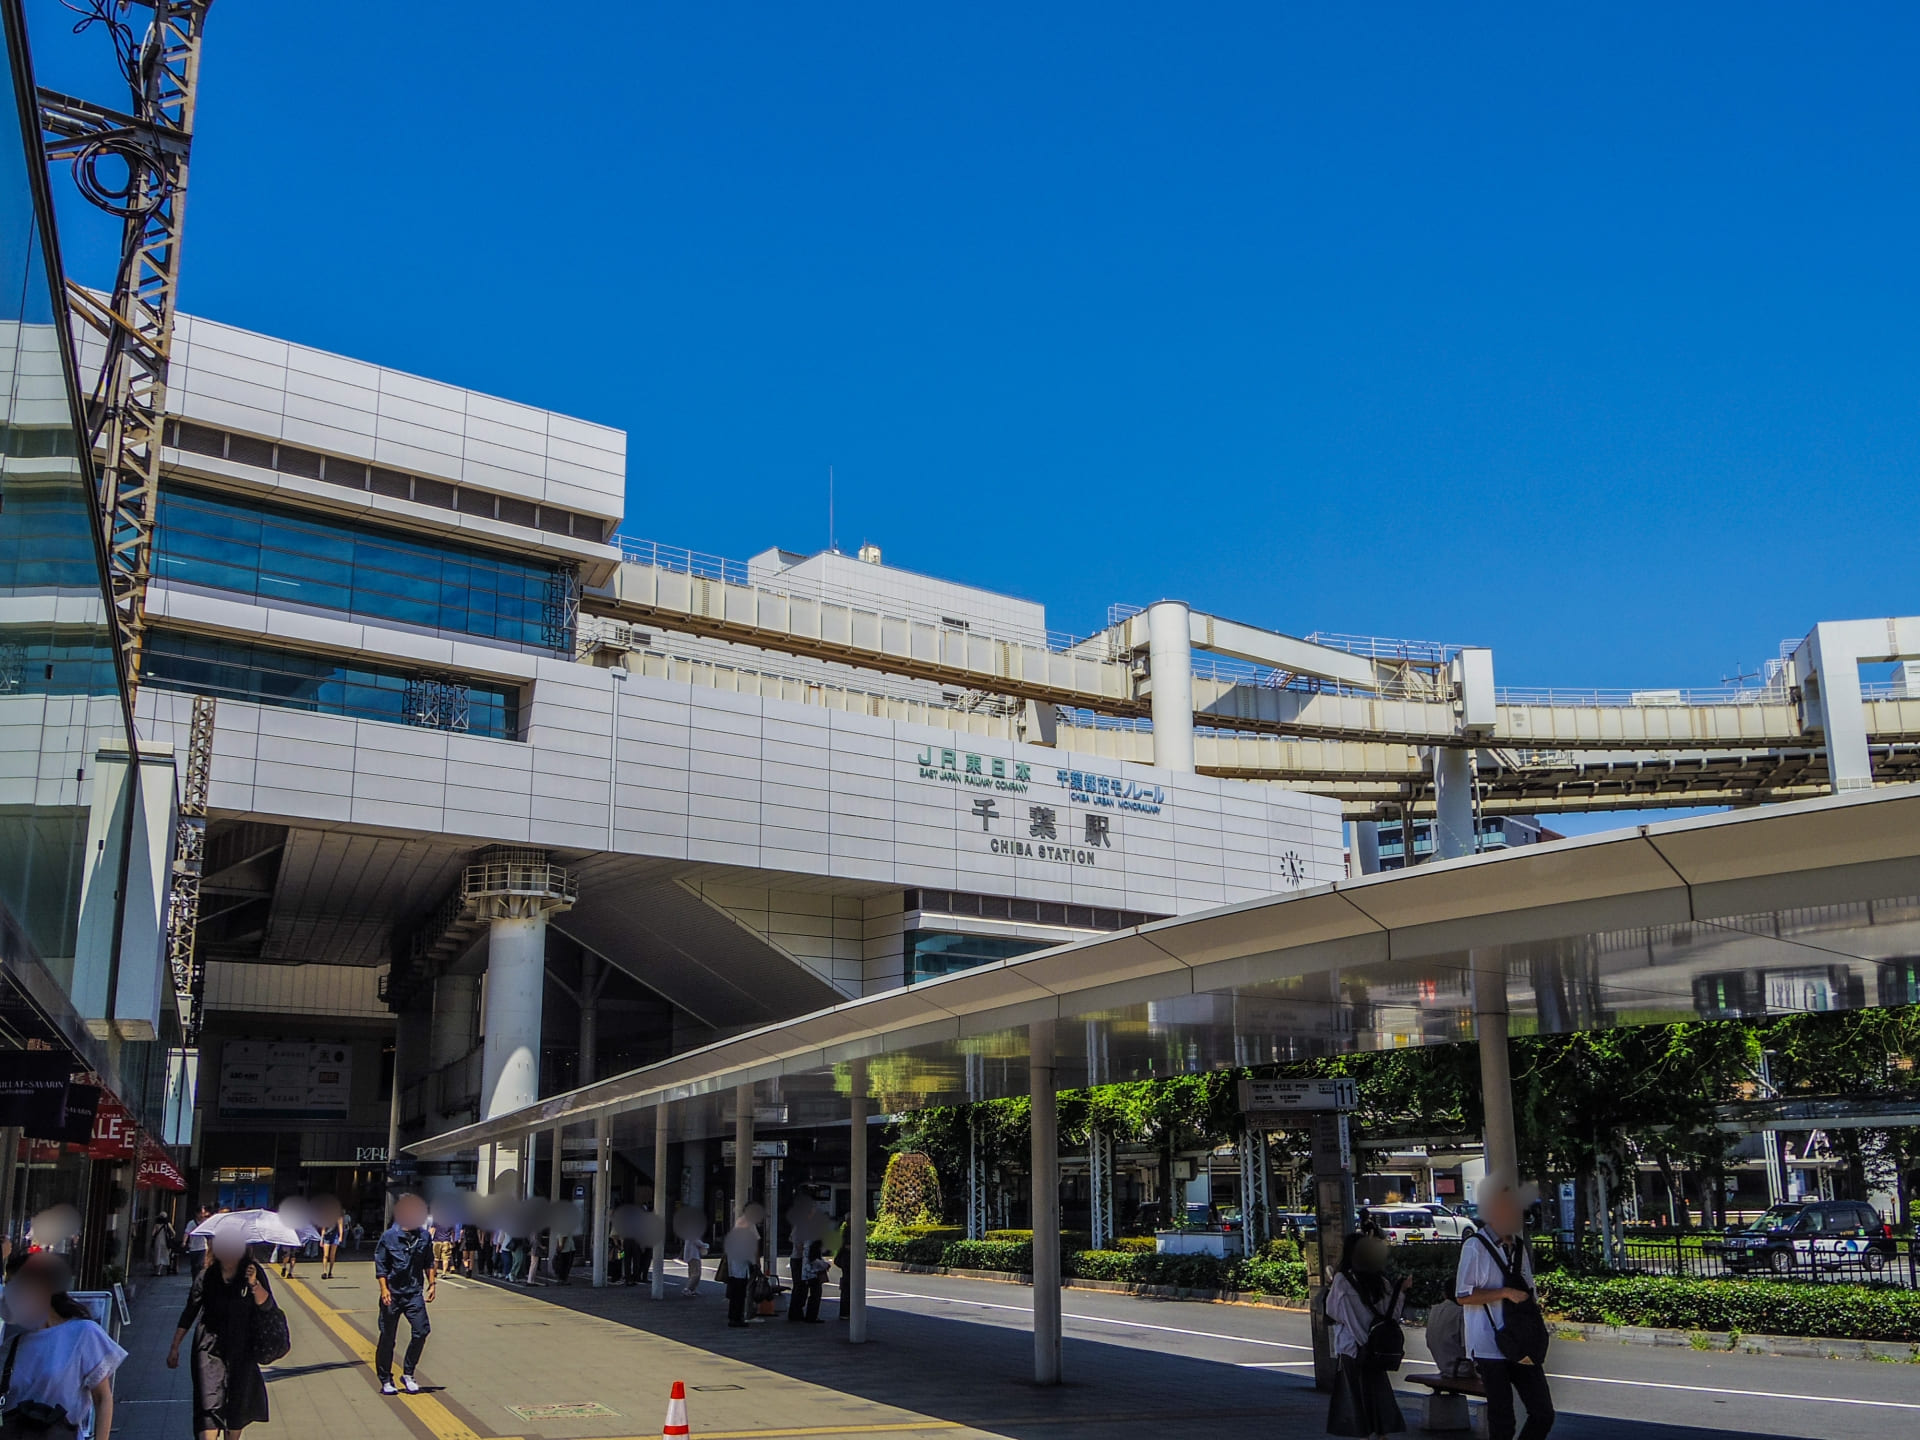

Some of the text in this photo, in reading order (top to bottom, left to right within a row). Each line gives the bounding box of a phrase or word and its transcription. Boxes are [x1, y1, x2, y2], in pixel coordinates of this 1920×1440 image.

[918, 747, 1031, 781] JR東日本
[919, 767, 1029, 794] EAST JAPAN RAILWAY COMPANY
[1056, 769, 1165, 805] 千葉都市モノレール
[1071, 792, 1090, 804] CHIBA
[1094, 796, 1115, 808] URBAN
[971, 798, 1111, 849] 千葉駅
[990, 838, 1095, 865] CHIBA STATION
[1337, 1083, 1354, 1105] 11
[140, 1163, 168, 1174] SALE
